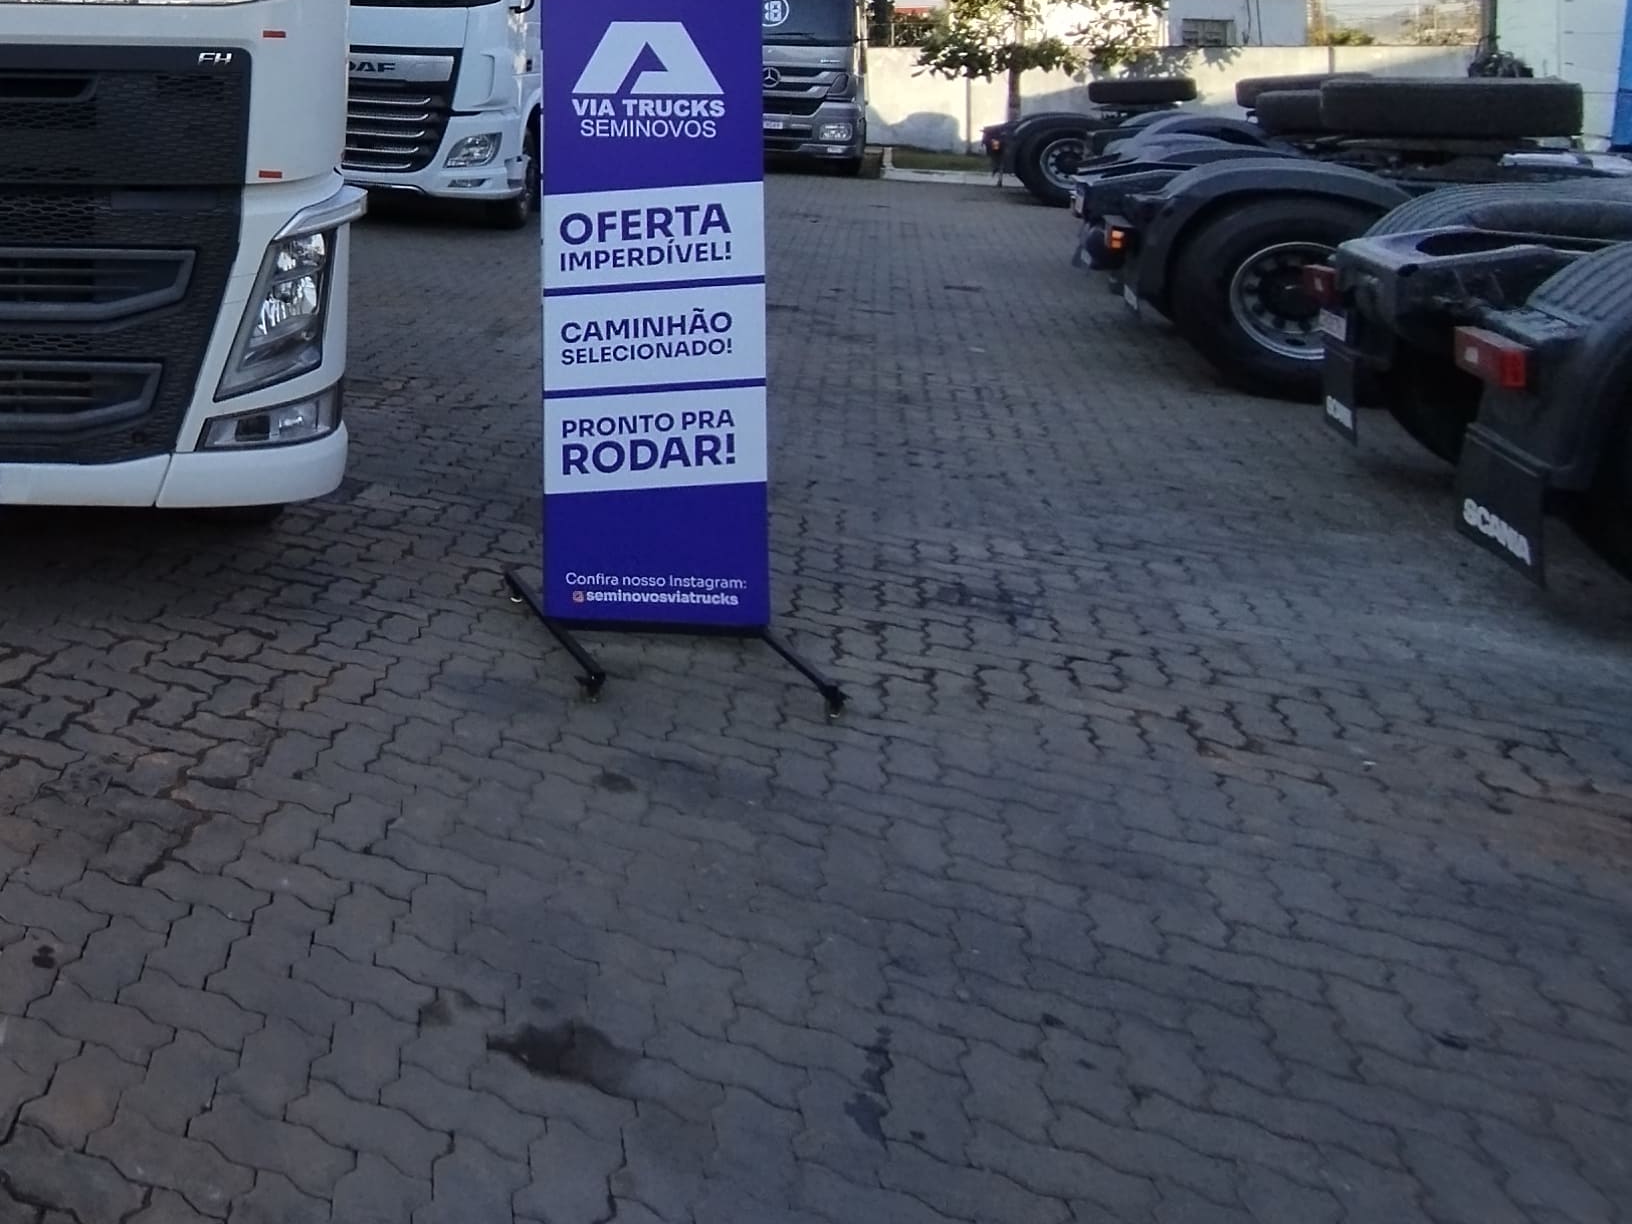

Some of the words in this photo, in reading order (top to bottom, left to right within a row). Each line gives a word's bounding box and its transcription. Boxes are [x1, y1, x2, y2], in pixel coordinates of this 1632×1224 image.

[198, 52, 233, 64] FH
[571, 98, 616, 116] VIA
[622, 99, 726, 117] TRUCKS
[580, 119, 717, 138] SEMINOVOS
[559, 202, 732, 246] OFERTA
[560, 238, 732, 272] IMPERDÍVEL!
[560, 307, 733, 344] CAMINHÃO
[561, 338, 733, 365] SELECIONADO!
[561, 412, 675, 439] PRONTO
[681, 408, 736, 431] PRA
[561, 432, 736, 476] RODAR!
[565, 572, 619, 586] Confira
[622, 575, 666, 587] nosso
[669, 574, 747, 591] Instagram:
